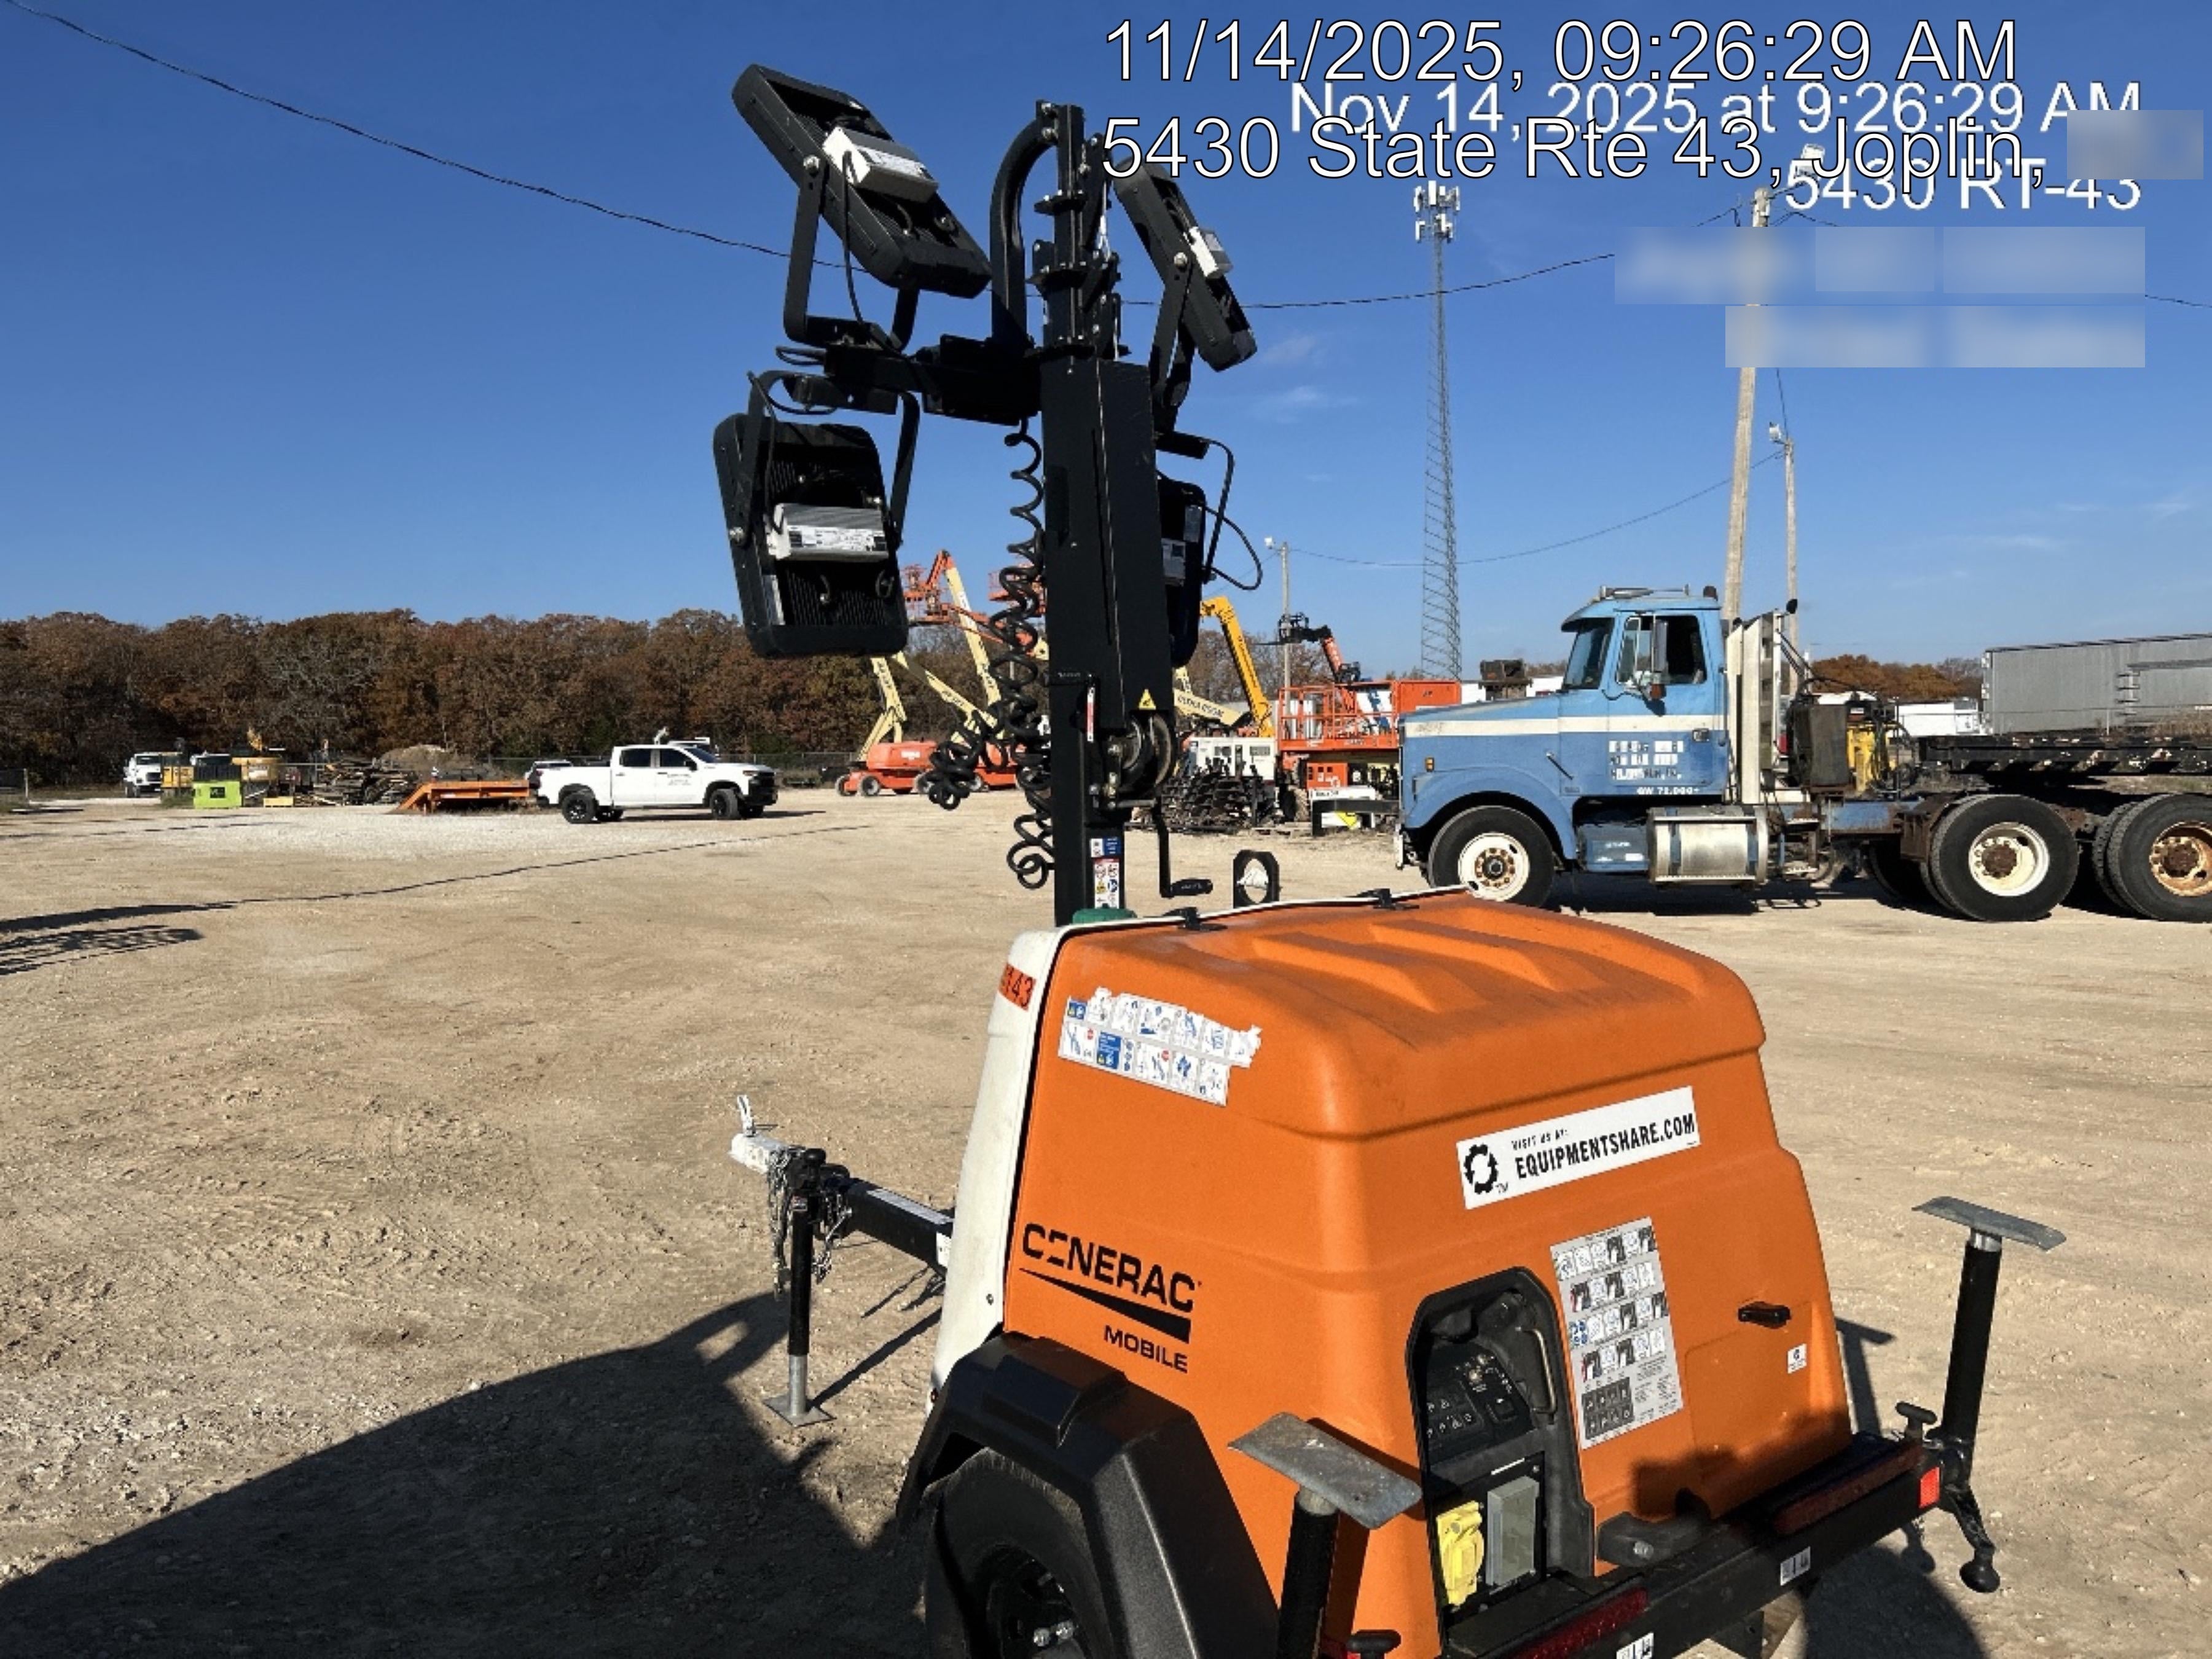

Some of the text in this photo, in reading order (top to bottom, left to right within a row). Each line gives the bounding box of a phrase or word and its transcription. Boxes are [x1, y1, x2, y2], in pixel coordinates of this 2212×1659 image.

[1512, 1135, 1536, 1150] VISIT
[1515, 1113, 1695, 1179] EQUIPMENTSHARE.COM
[1104, 1324, 1188, 1374] MOBILE
